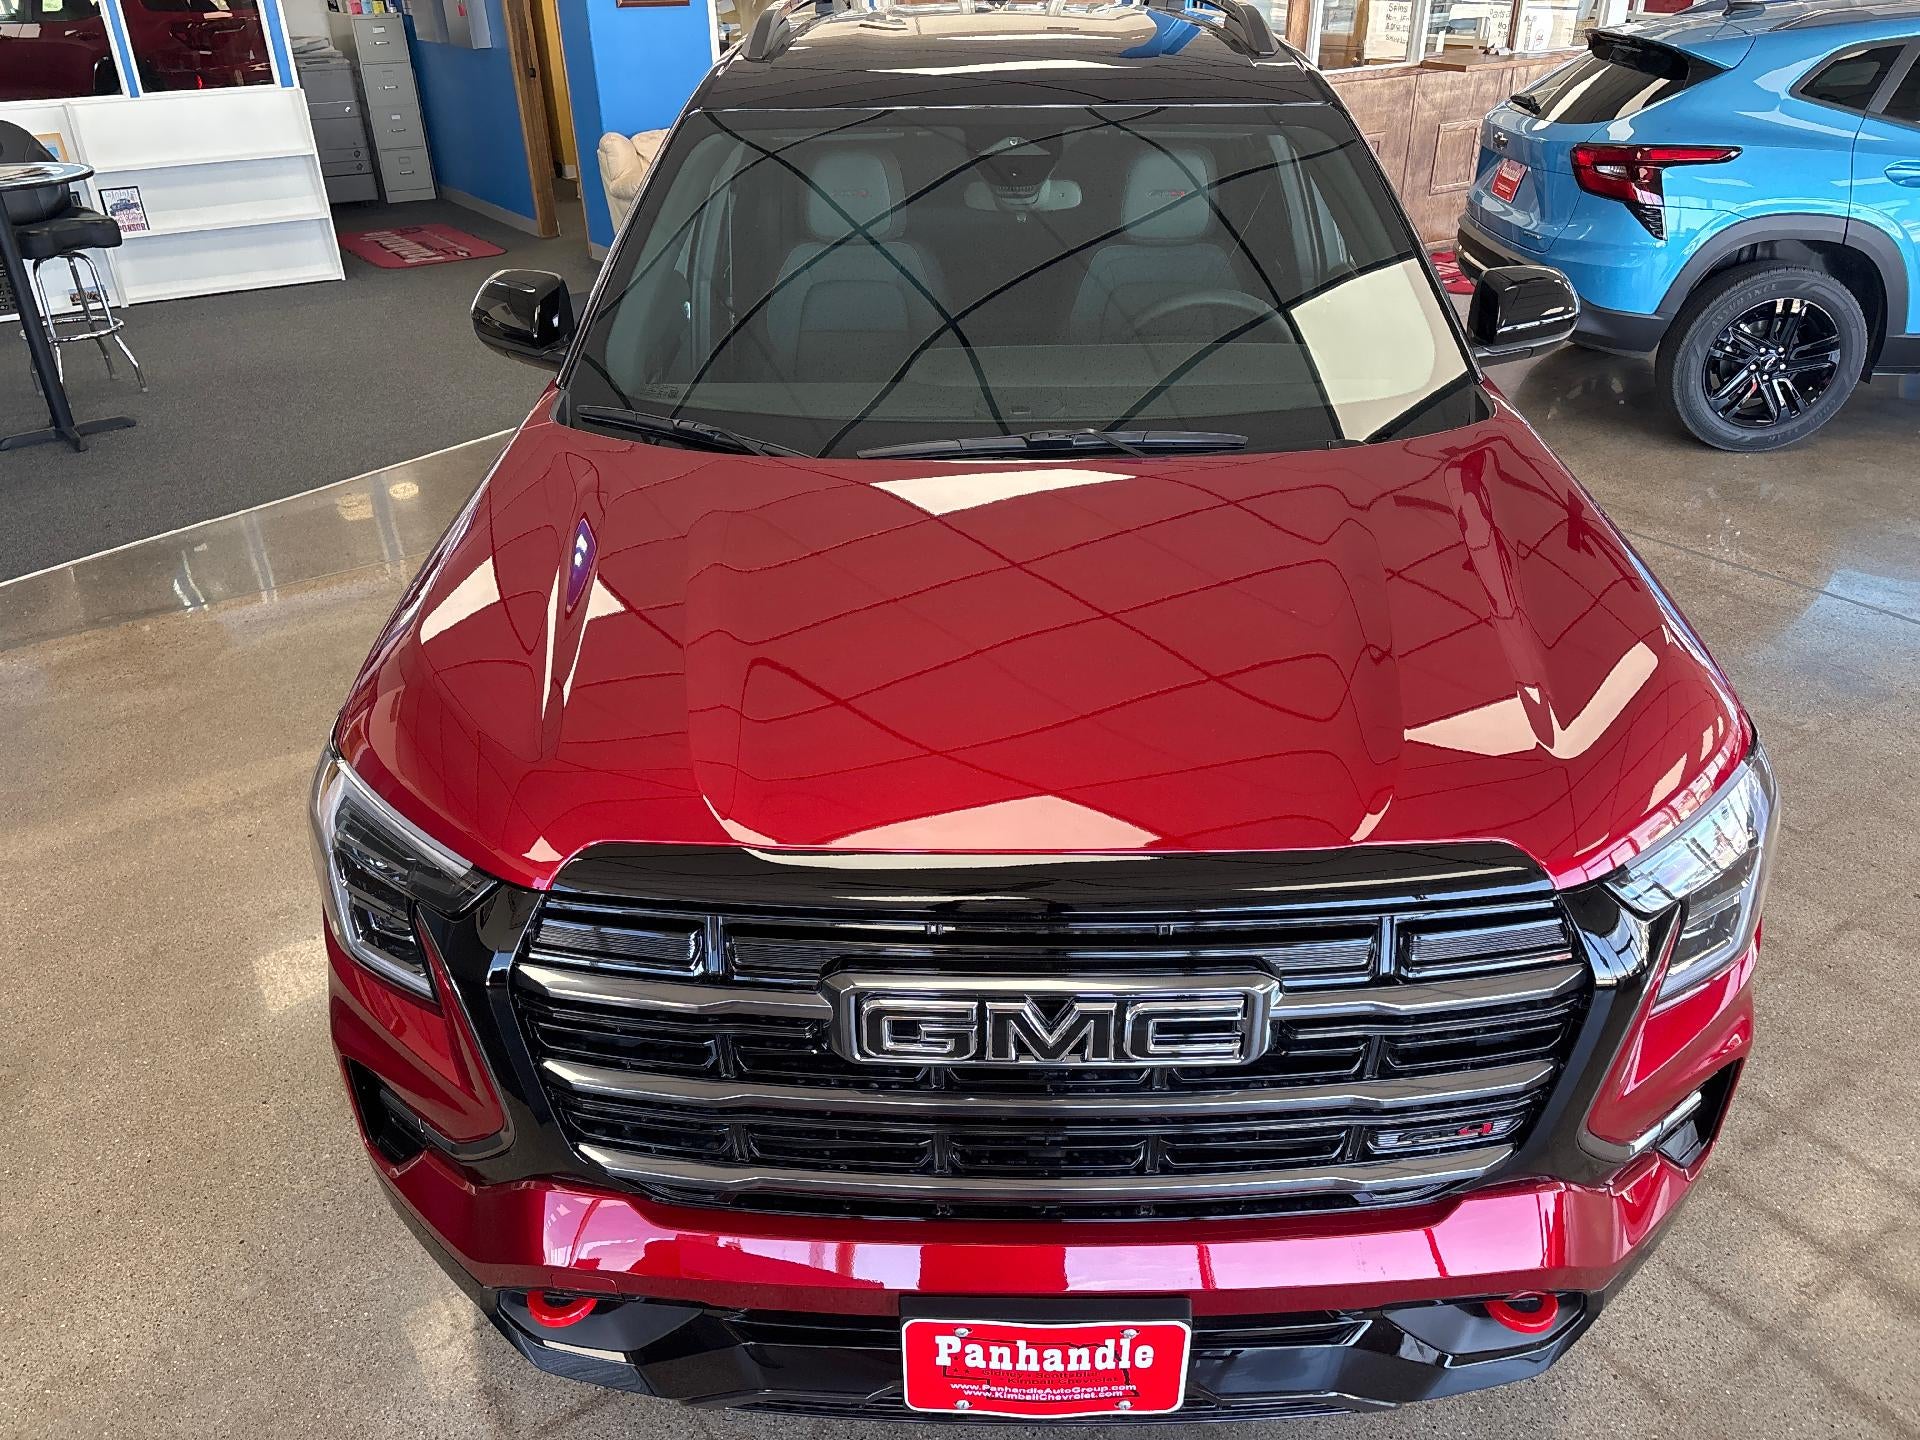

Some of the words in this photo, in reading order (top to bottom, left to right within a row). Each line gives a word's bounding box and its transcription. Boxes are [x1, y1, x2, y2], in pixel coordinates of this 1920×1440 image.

[861, 993, 1245, 1061] GMC
[934, 1334, 1155, 1373] Panhandle
[950, 1382, 1137, 1395] www.PanhandleAutoGroup.com
[963, 1388, 1123, 1401] www.KimballChevrolet.com
